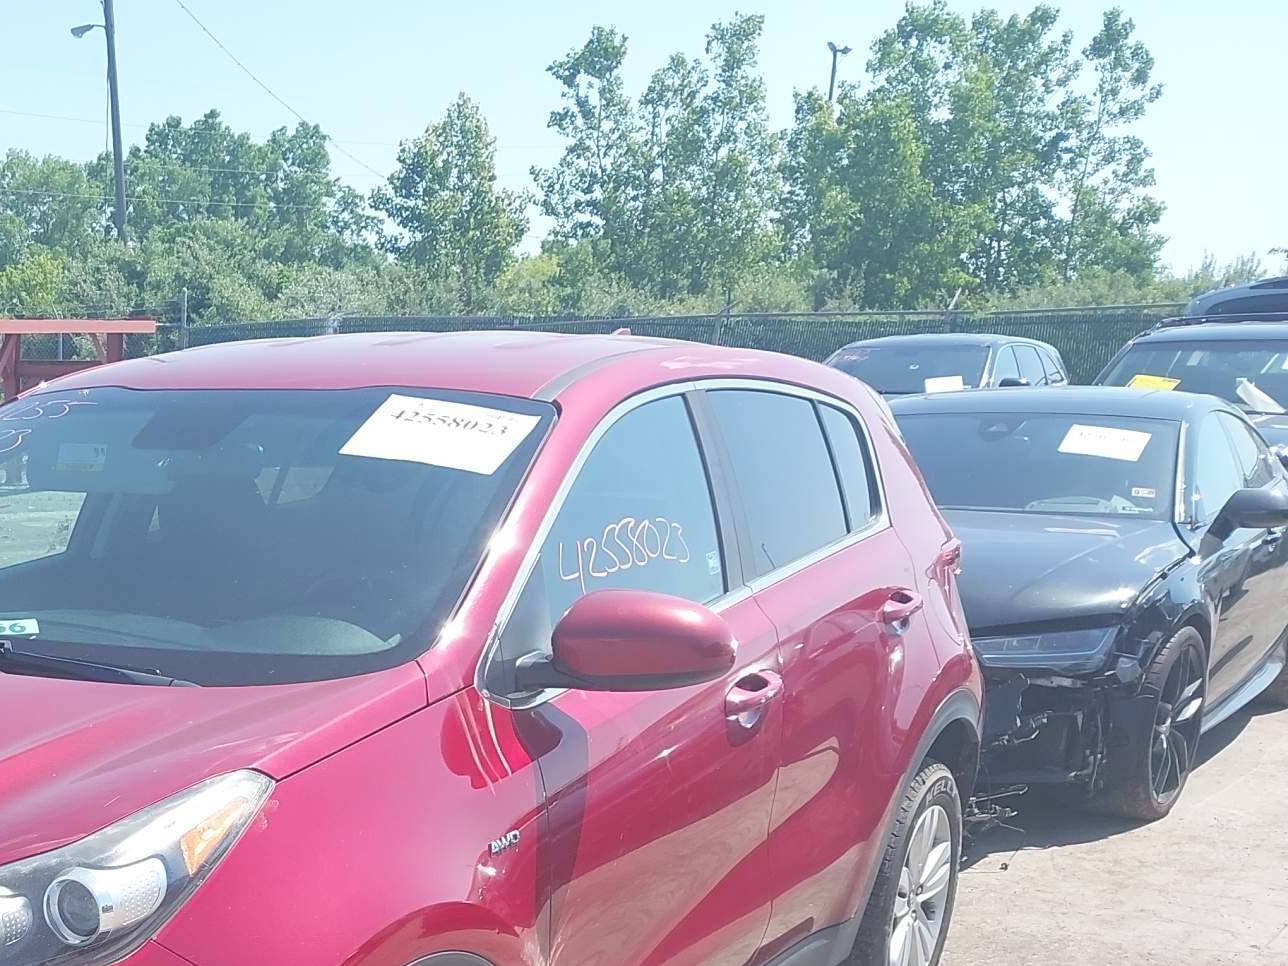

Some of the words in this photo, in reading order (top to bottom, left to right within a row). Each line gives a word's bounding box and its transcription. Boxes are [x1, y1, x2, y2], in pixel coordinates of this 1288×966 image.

[390, 409, 510, 435] 42558023
[559, 517, 690, 595] 42558023
[491, 829, 520, 853] AWD
